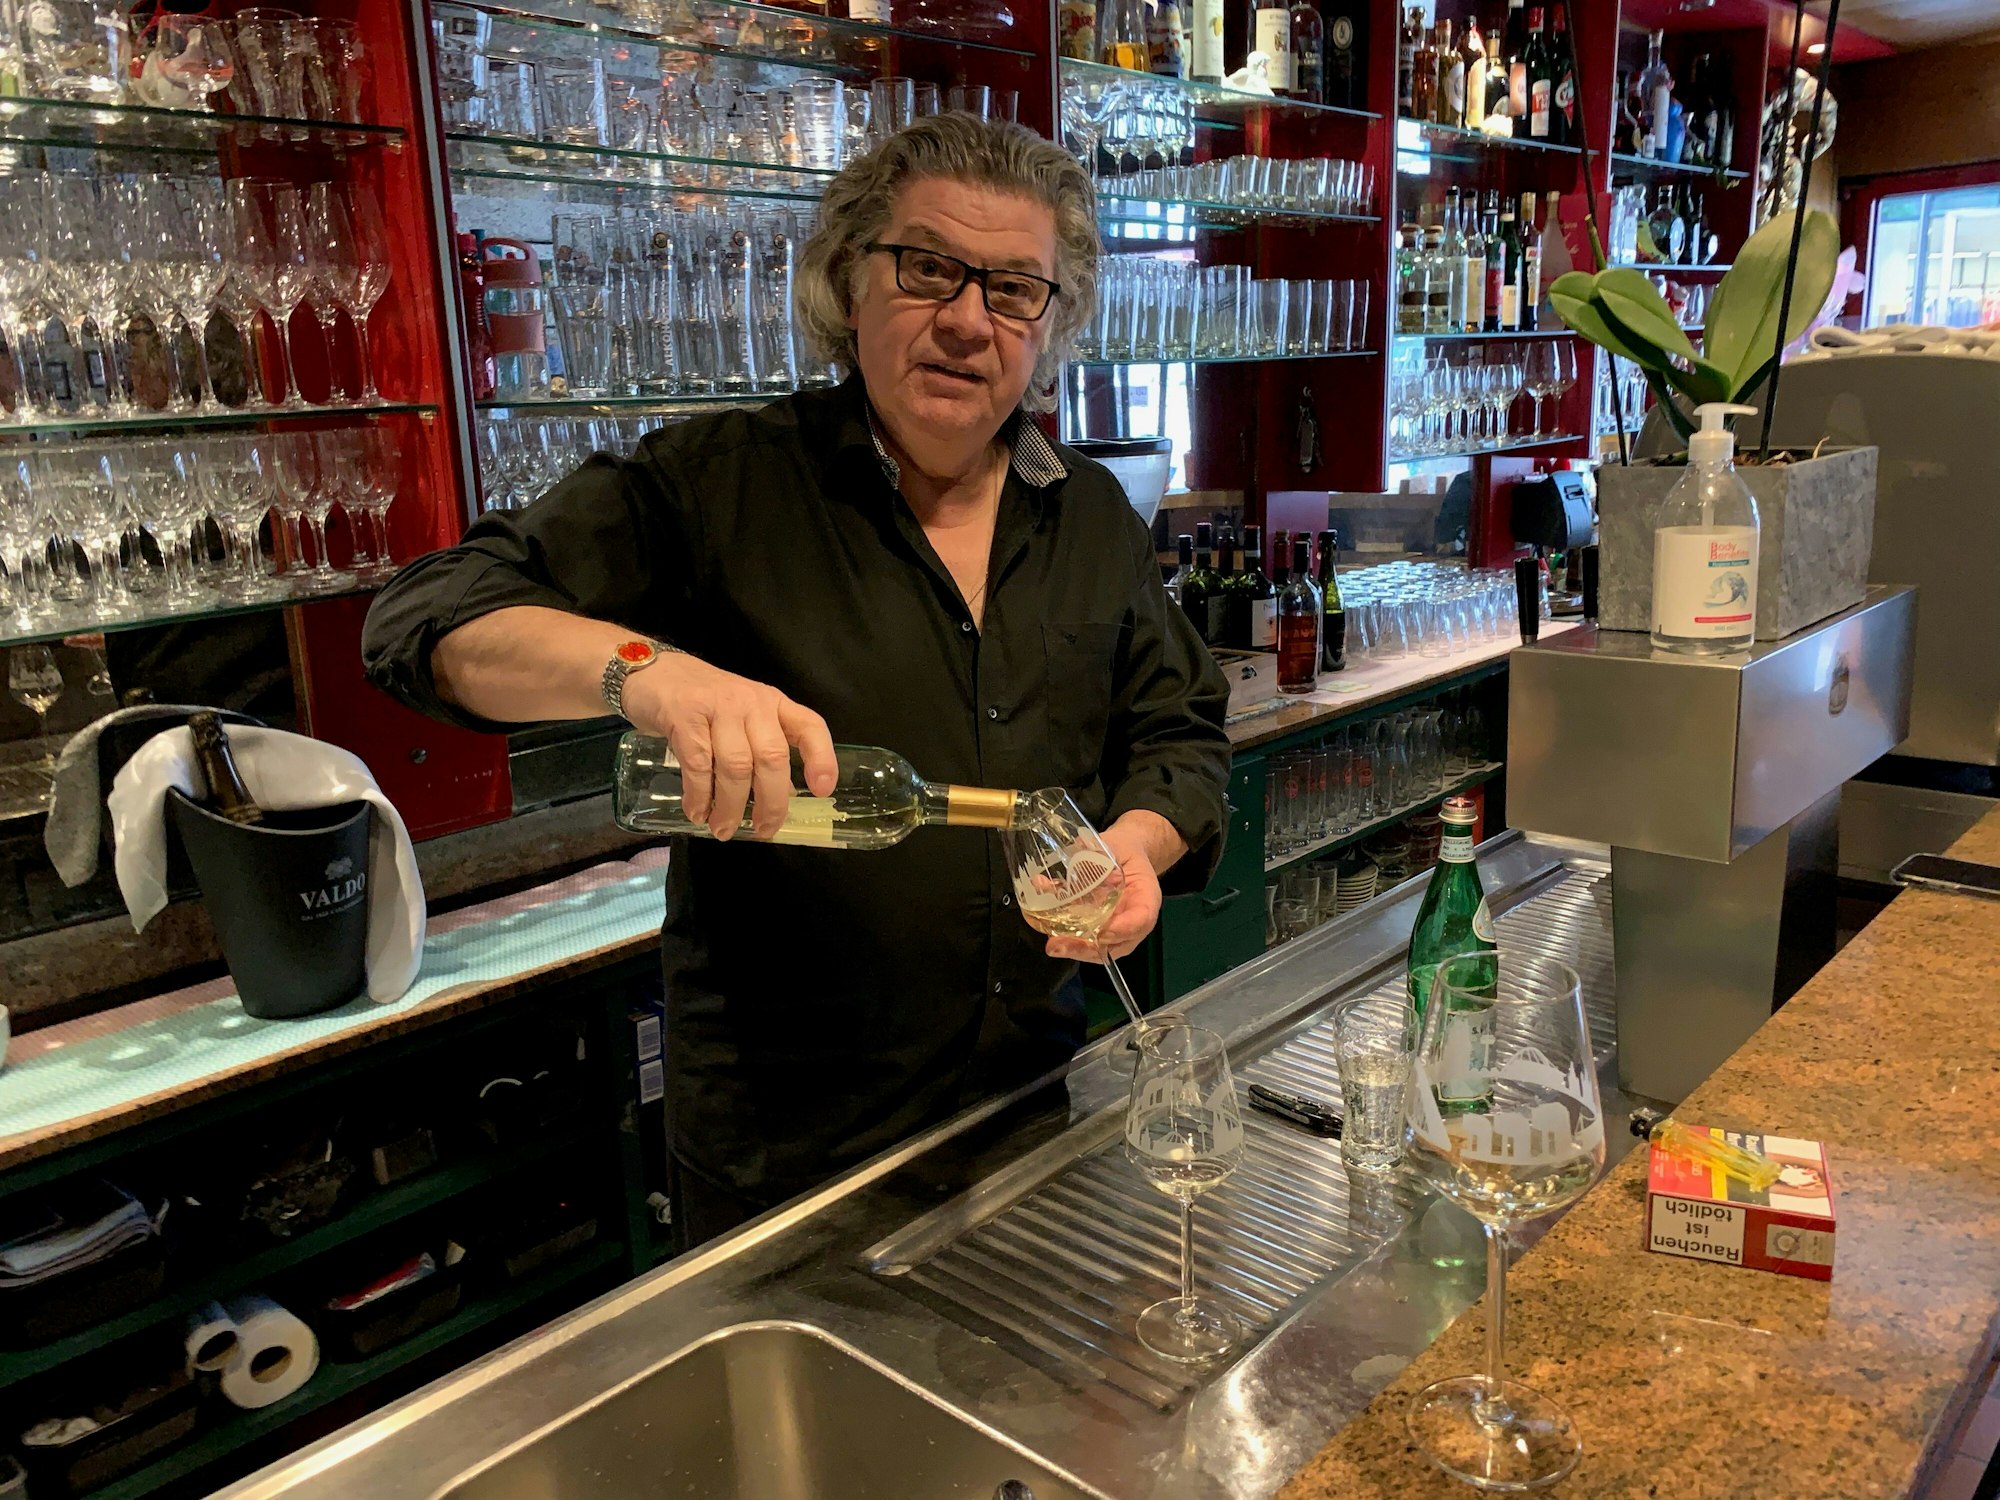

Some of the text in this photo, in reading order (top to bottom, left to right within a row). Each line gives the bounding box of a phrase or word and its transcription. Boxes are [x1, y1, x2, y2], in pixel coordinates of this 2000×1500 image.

[1711, 542, 1737, 552] Body
[300, 872, 365, 910] VALDO
[1665, 1200, 1733, 1222] tödlich
[1686, 1222, 1709, 1238] ist
[1654, 1235, 1739, 1261] Rauchen
